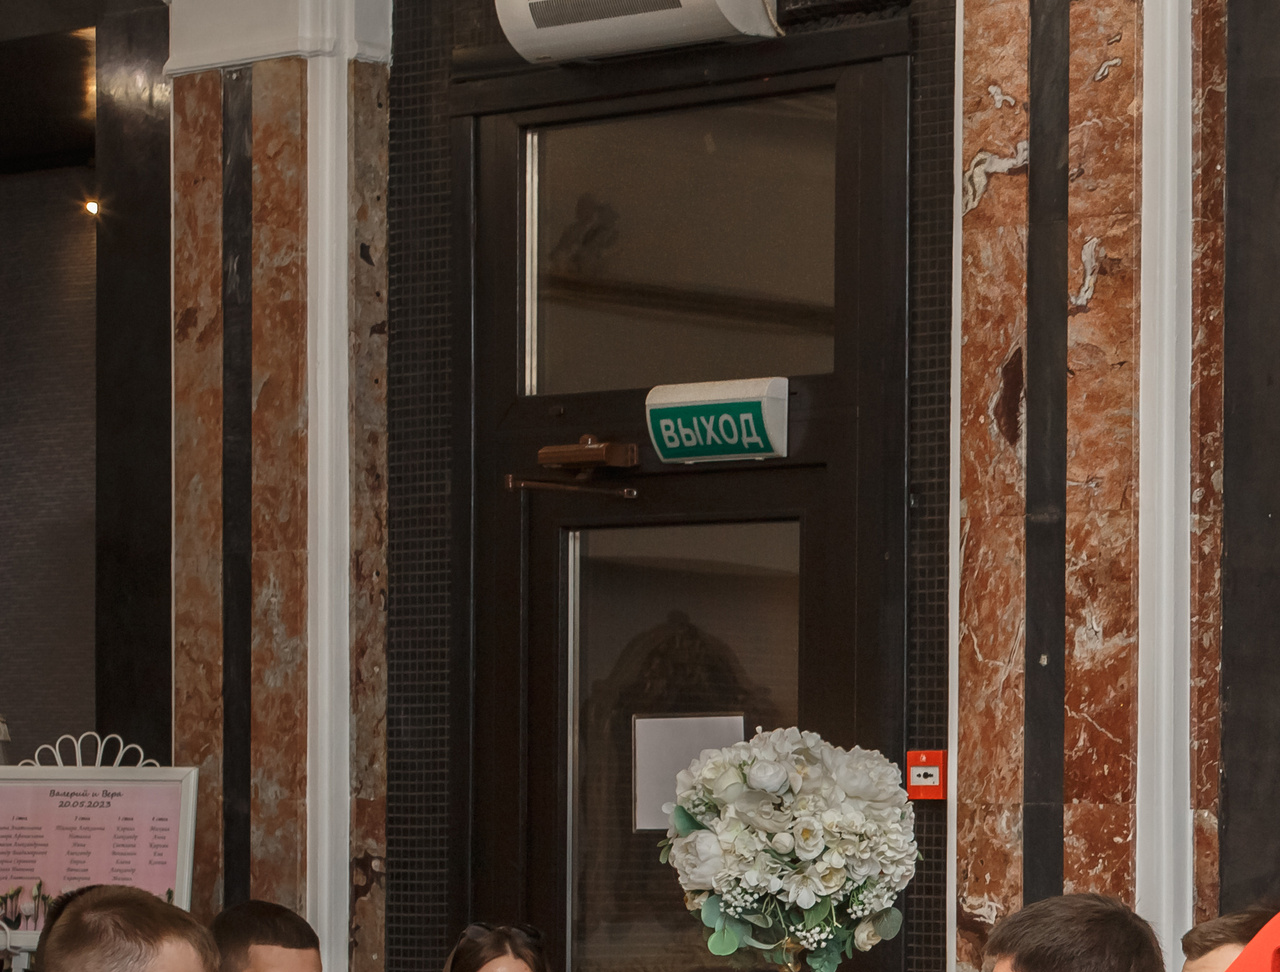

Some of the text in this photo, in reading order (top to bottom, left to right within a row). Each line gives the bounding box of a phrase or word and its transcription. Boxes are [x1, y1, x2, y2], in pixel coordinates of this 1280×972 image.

[659, 412, 765, 449] ВЫХОД
[49, 789, 90, 799] Валерий
[101, 789, 123, 800] Вера
[58, 800, 112, 808] 20.05.2023
